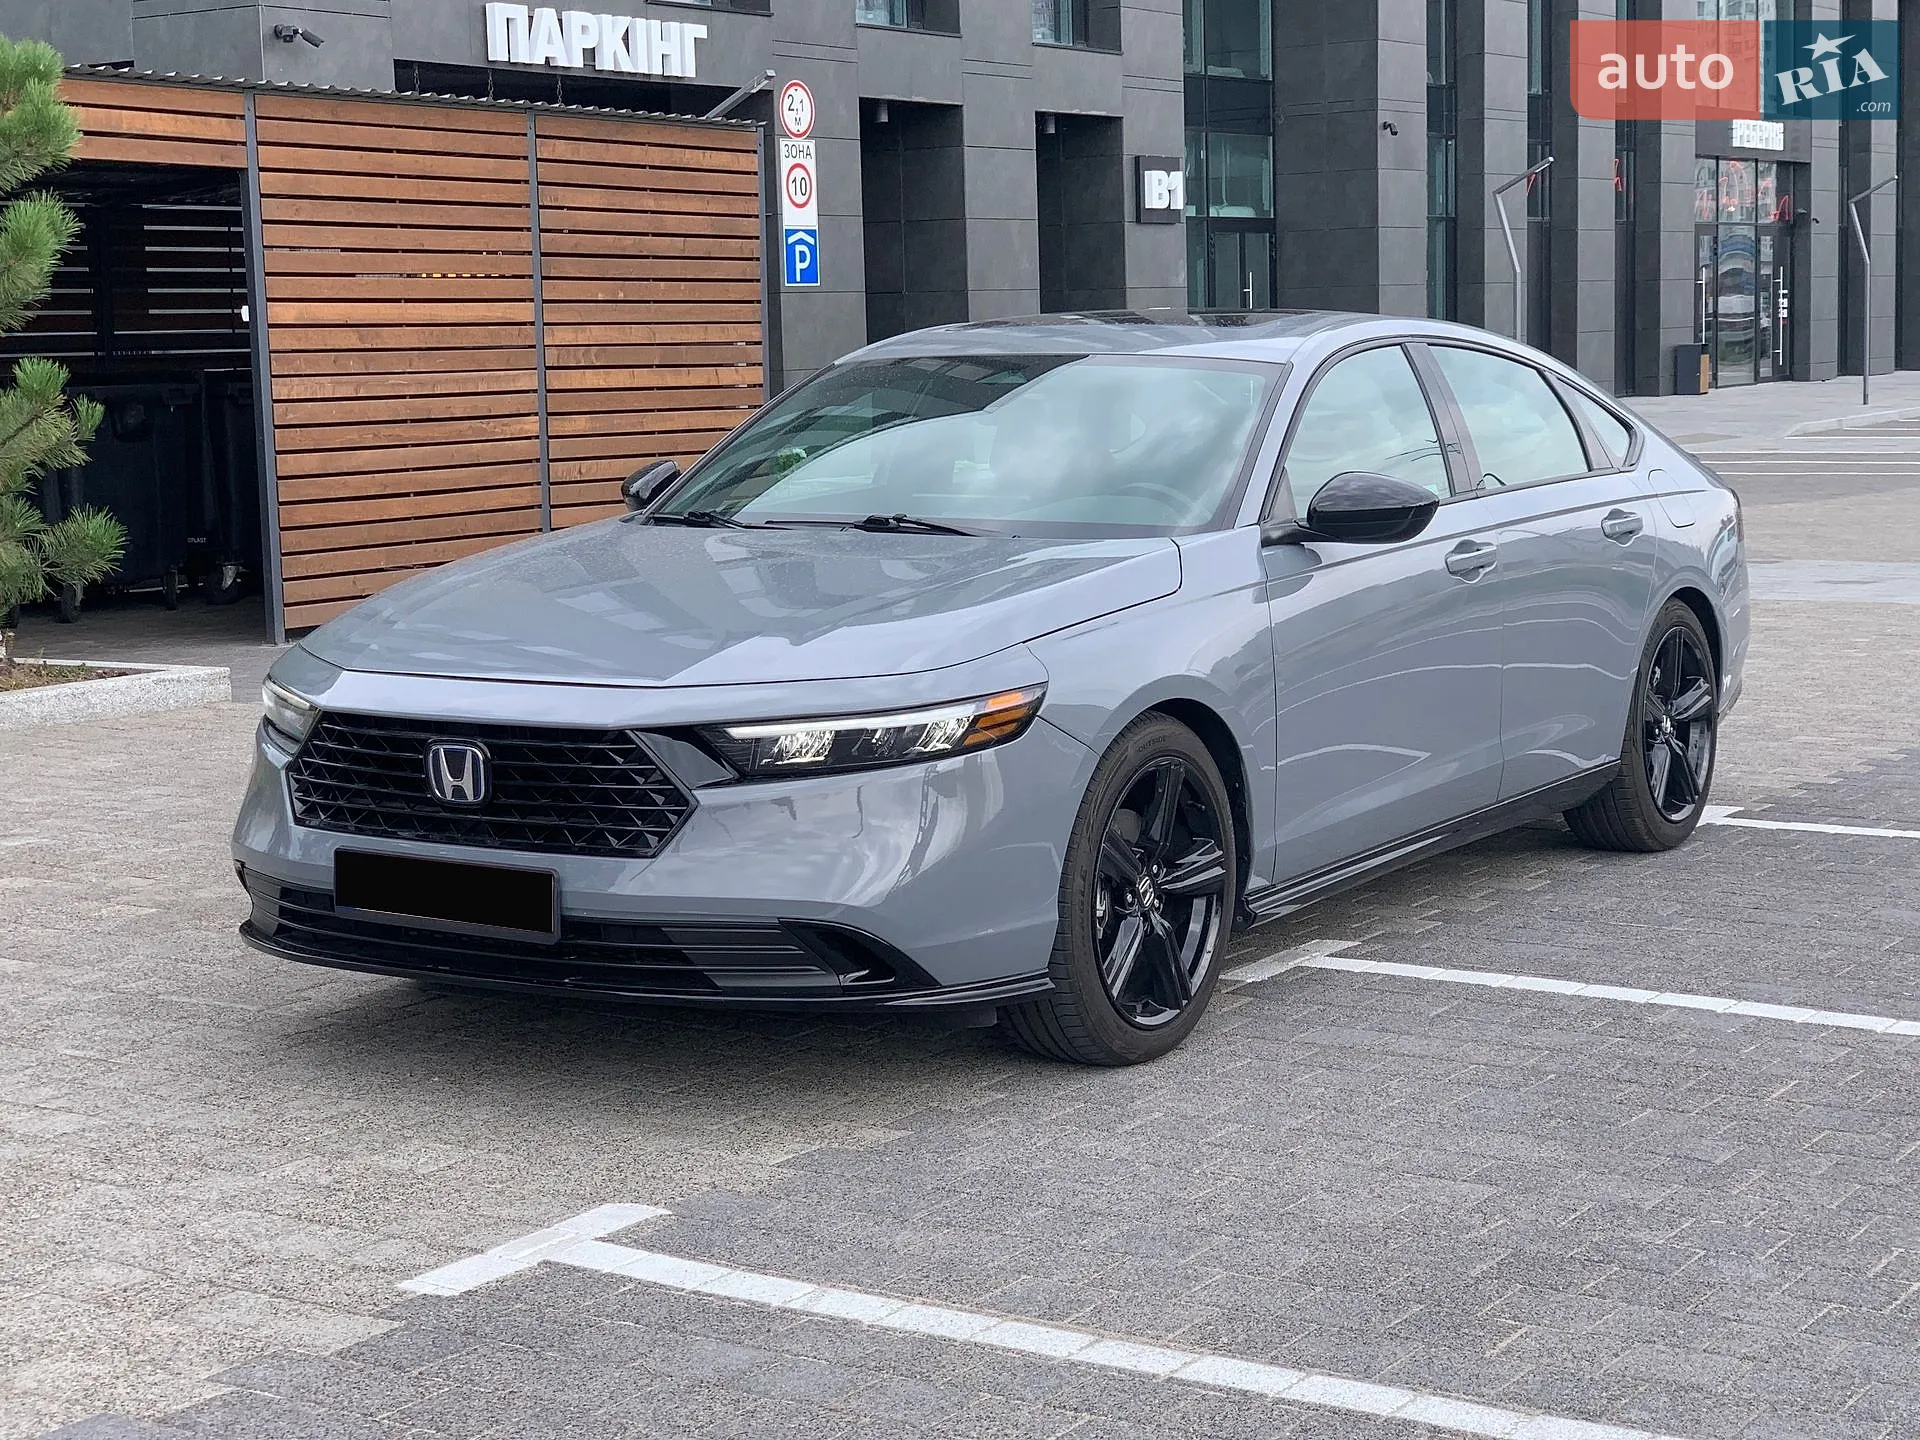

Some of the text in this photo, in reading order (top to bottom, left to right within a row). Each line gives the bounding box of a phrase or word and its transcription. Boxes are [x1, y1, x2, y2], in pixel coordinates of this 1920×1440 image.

[486, 2, 708, 78] ПАРКІНГ
[784, 143, 813, 160] ЗОНА
[791, 176, 808, 197] 10
[794, 244, 811, 283] P
